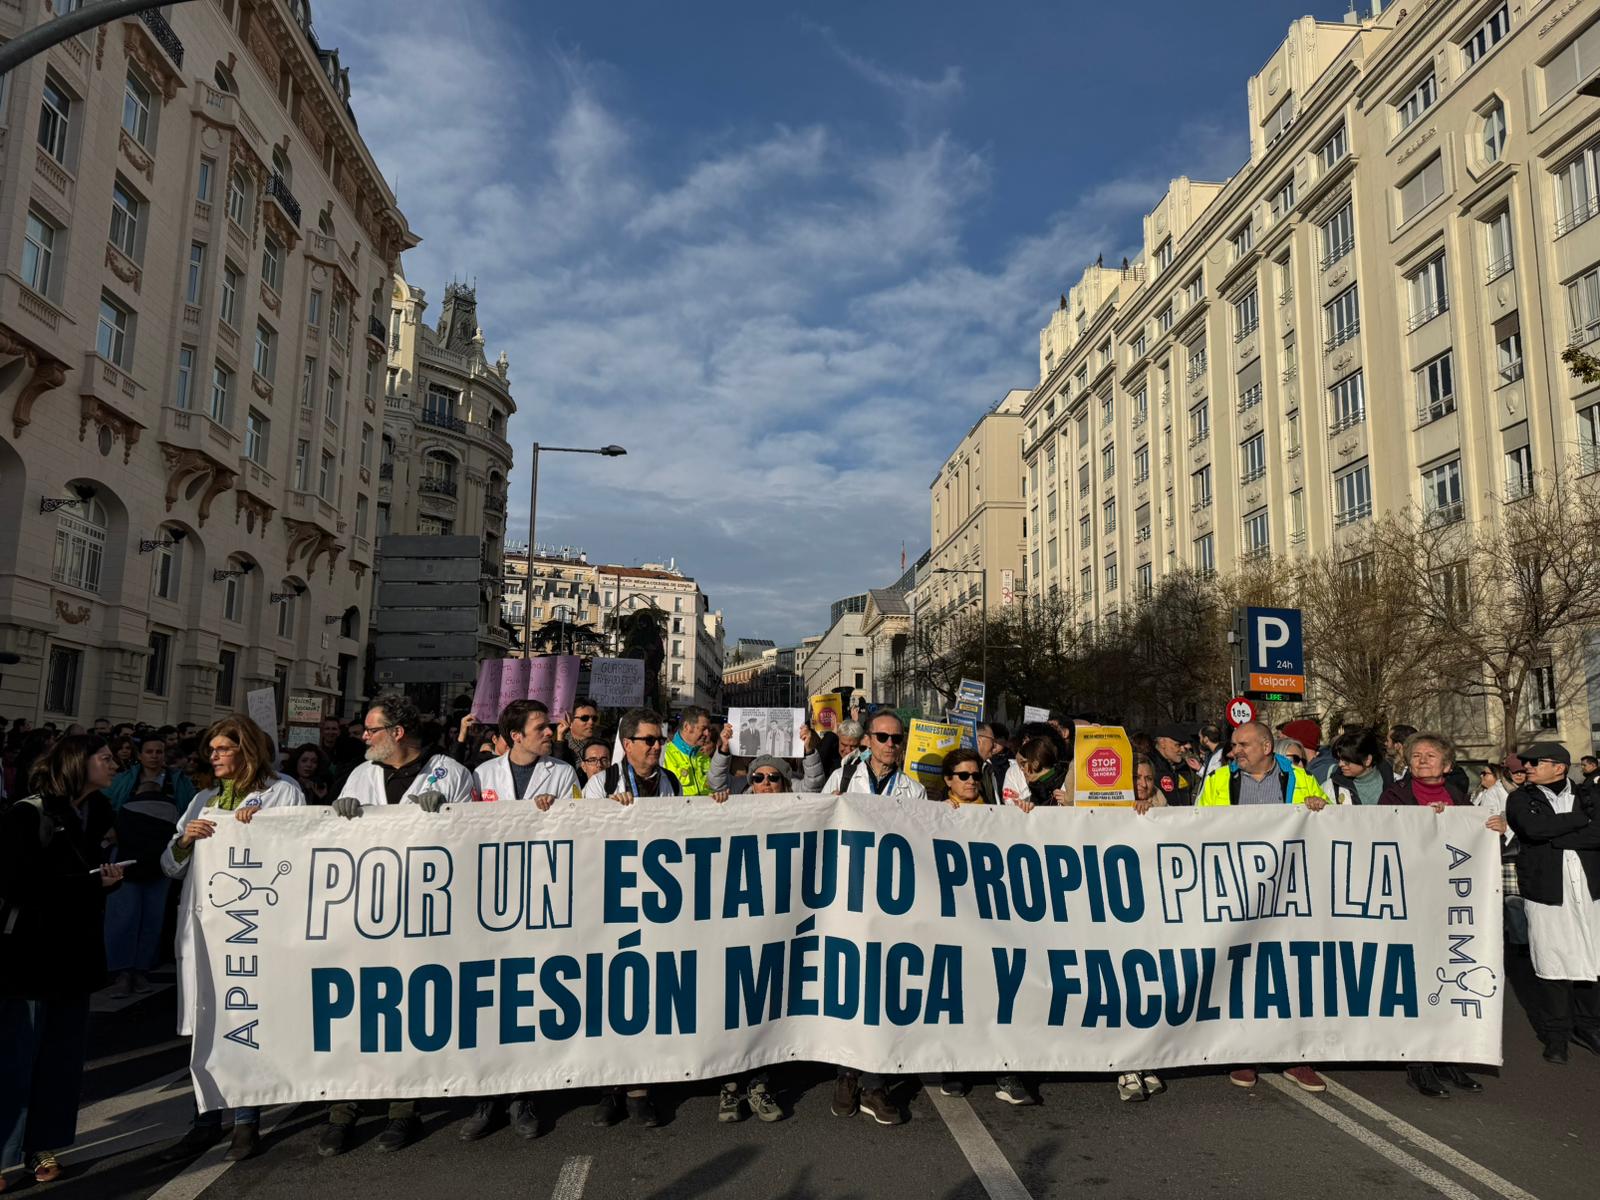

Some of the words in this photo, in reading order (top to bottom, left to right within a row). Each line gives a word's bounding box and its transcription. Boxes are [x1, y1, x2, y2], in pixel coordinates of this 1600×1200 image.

[1257, 616, 1290, 668] P
[1276, 660, 1293, 669] 24h
[1259, 675, 1296, 688] telpark
[1092, 758, 1116, 767] STOP
[305, 846, 454, 940] POR
[477, 839, 574, 932] UN
[602, 829, 916, 924] ESTATUTO
[932, 838, 1146, 923] PROPIO
[1156, 839, 1313, 924] PARA
[1331, 840, 1408, 920] LA
[310, 928, 698, 1053] PROFESIÓN
[724, 913, 965, 1031] MÉDICA
[991, 947, 1027, 1025] Y
[1046, 940, 1419, 1029] FACULTATIVA
